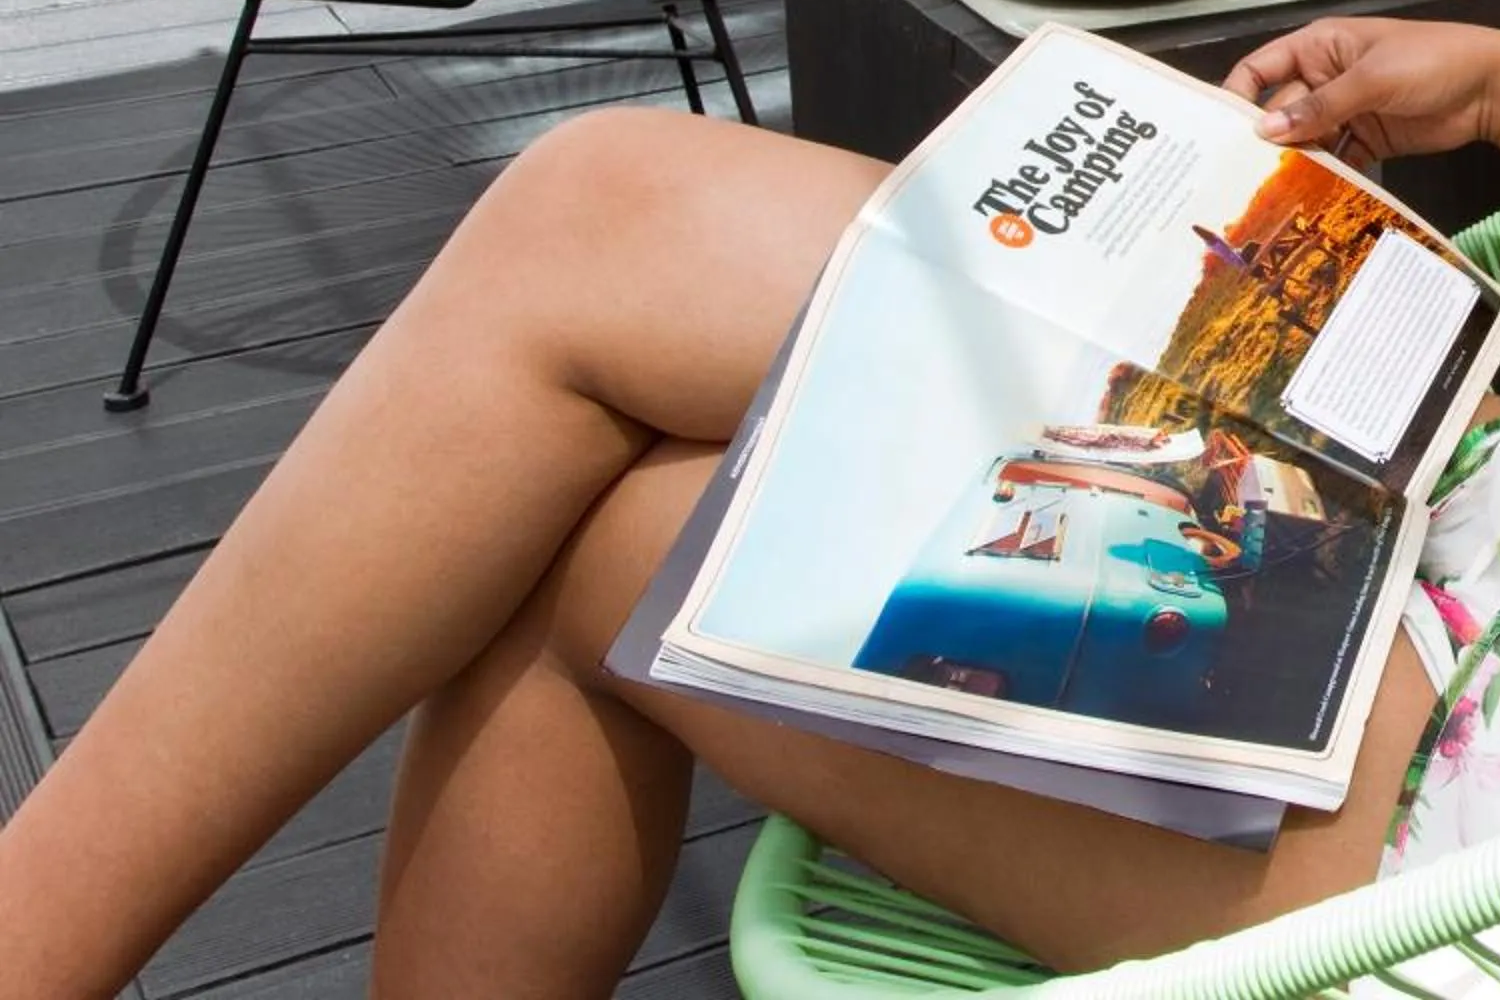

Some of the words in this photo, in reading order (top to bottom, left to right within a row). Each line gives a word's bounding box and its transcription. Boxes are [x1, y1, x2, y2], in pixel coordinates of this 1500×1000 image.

[973, 165, 1050, 217] The
[1023, 116, 1096, 174] Joy
[1073, 79, 1117, 120] of
[1027, 110, 1158, 235] Camping
